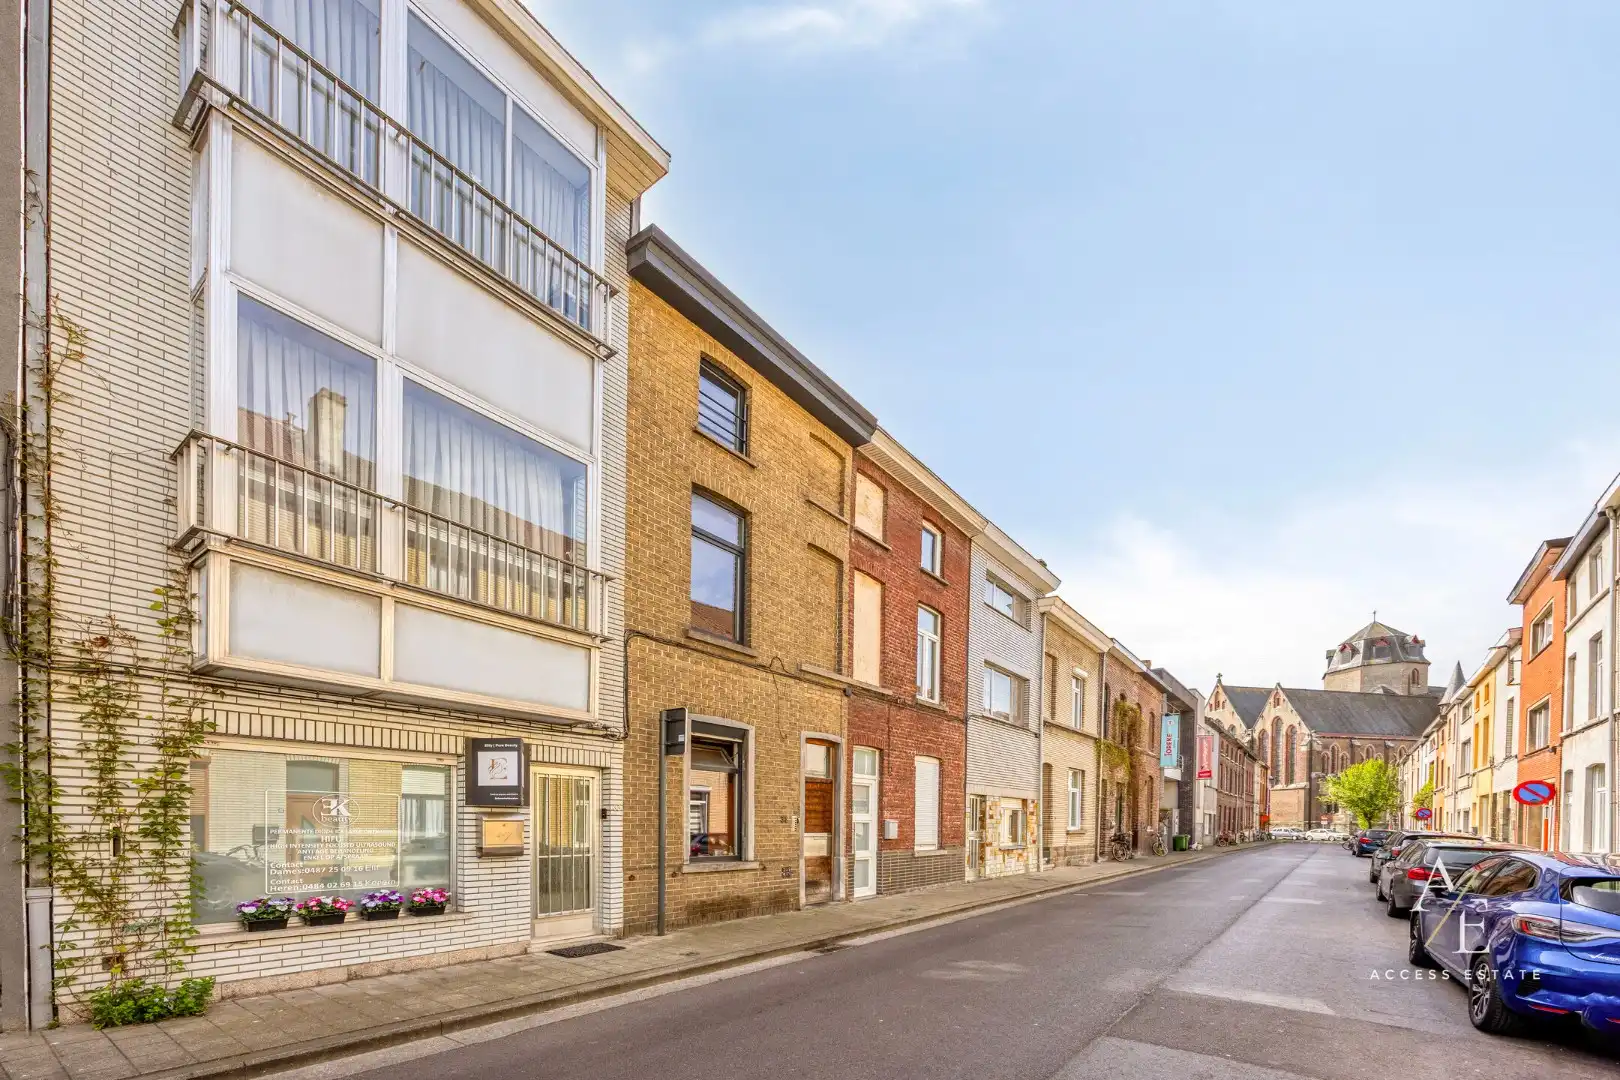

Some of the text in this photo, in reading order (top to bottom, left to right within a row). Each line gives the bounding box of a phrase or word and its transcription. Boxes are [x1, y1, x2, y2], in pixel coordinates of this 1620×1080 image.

[321, 816, 354, 824] beauty
[270, 861, 304, 869] Contact
[270, 878, 303, 886] Contact
